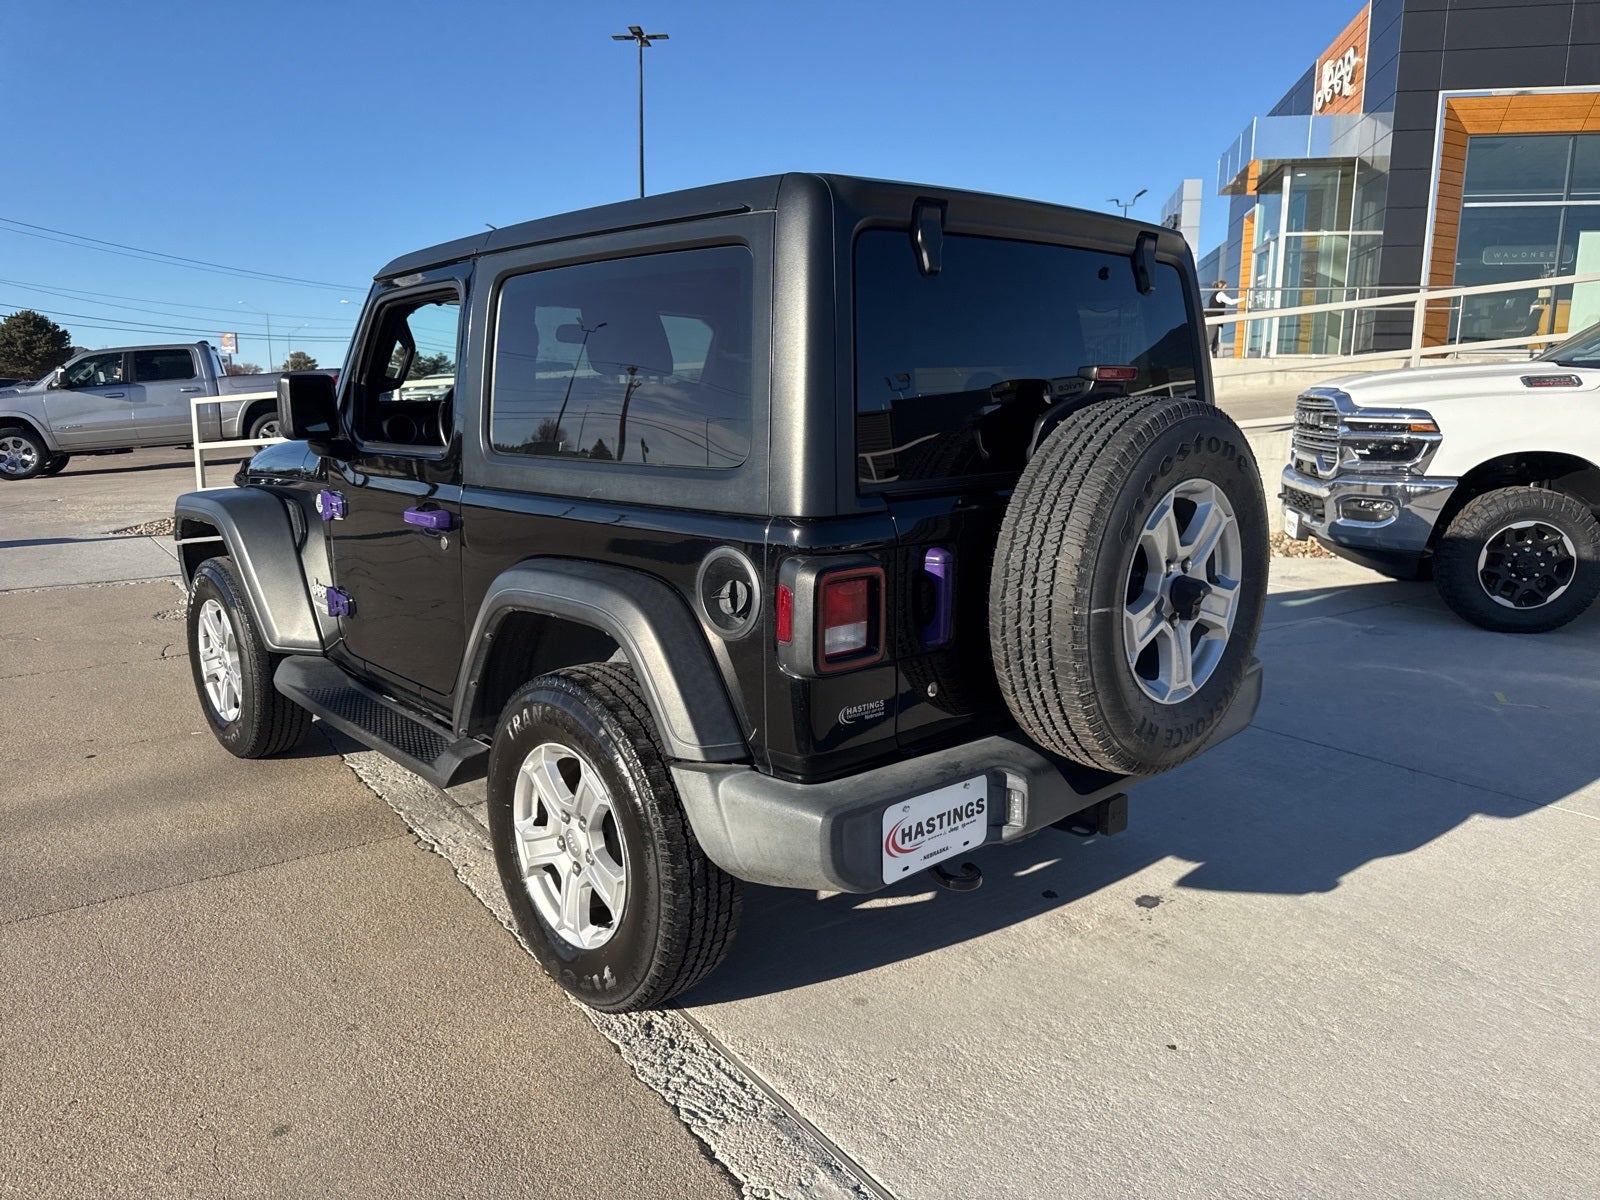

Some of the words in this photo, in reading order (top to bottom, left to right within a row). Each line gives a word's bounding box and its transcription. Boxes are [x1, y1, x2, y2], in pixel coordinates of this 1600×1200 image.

[846, 699, 885, 715] HASTINGS
[901, 798, 985, 846] HASTINGS
[923, 845, 949, 860] NEBRASKA
